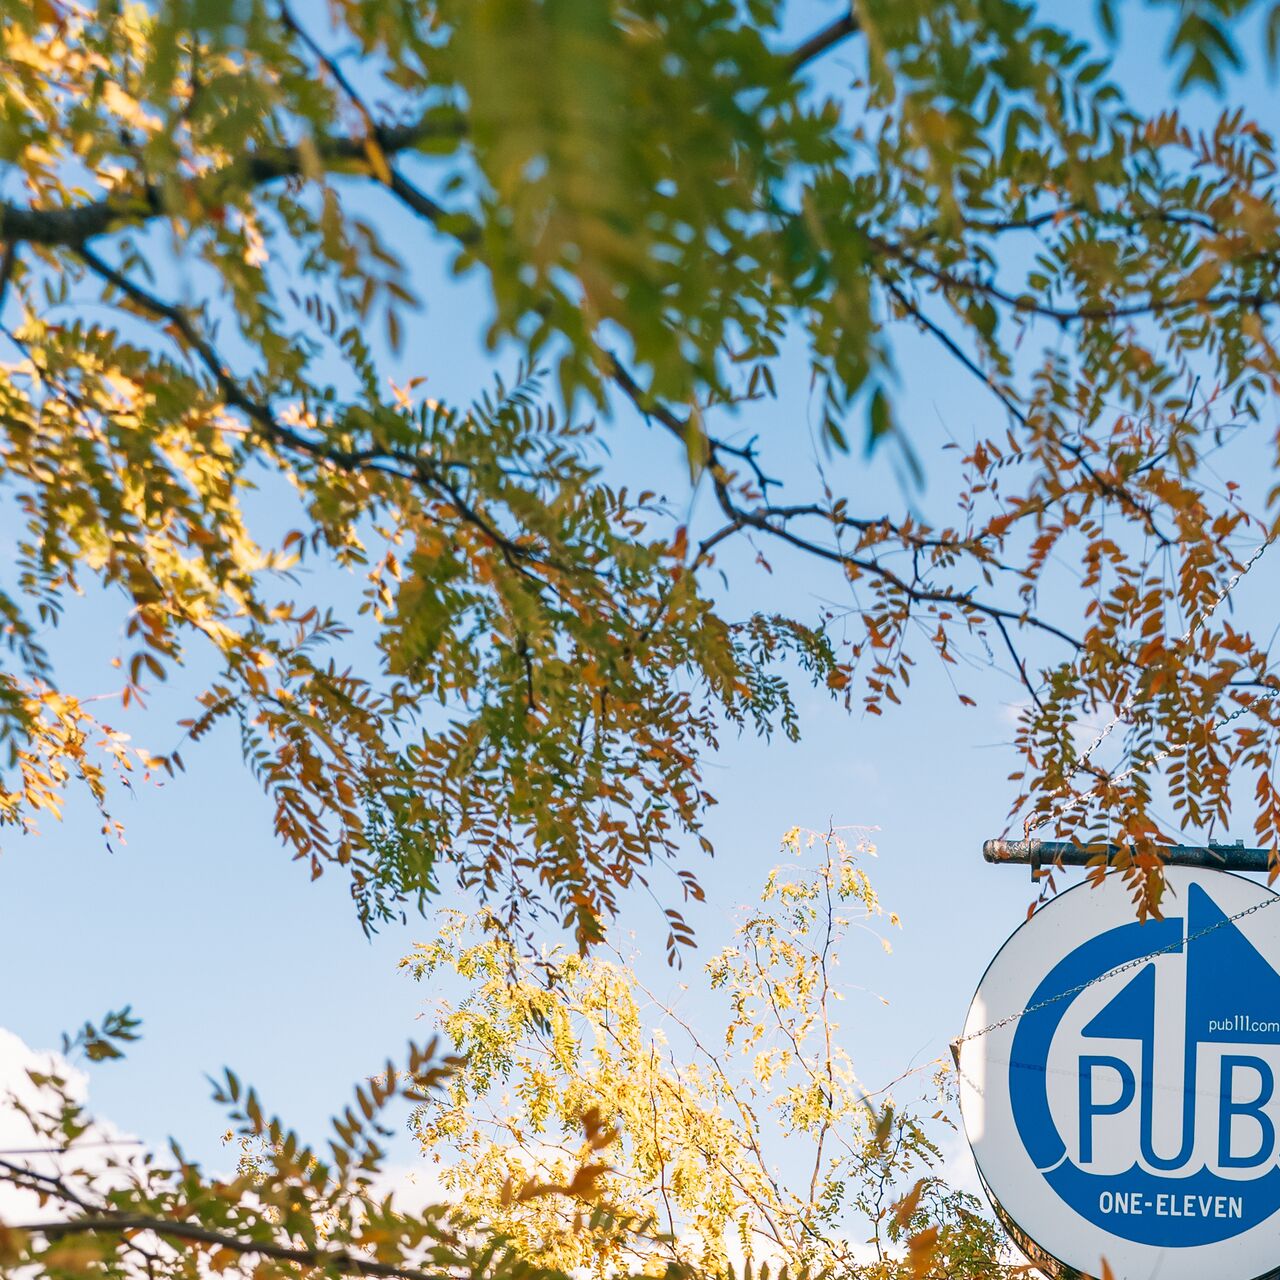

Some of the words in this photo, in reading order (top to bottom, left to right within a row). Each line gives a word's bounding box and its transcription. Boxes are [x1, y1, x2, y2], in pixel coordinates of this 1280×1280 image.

[1208, 1014, 1280, 1033] pub111.com
[1078, 1054, 1276, 1171] PUB
[1099, 1190, 1243, 1219] ONE-ELEVEN
